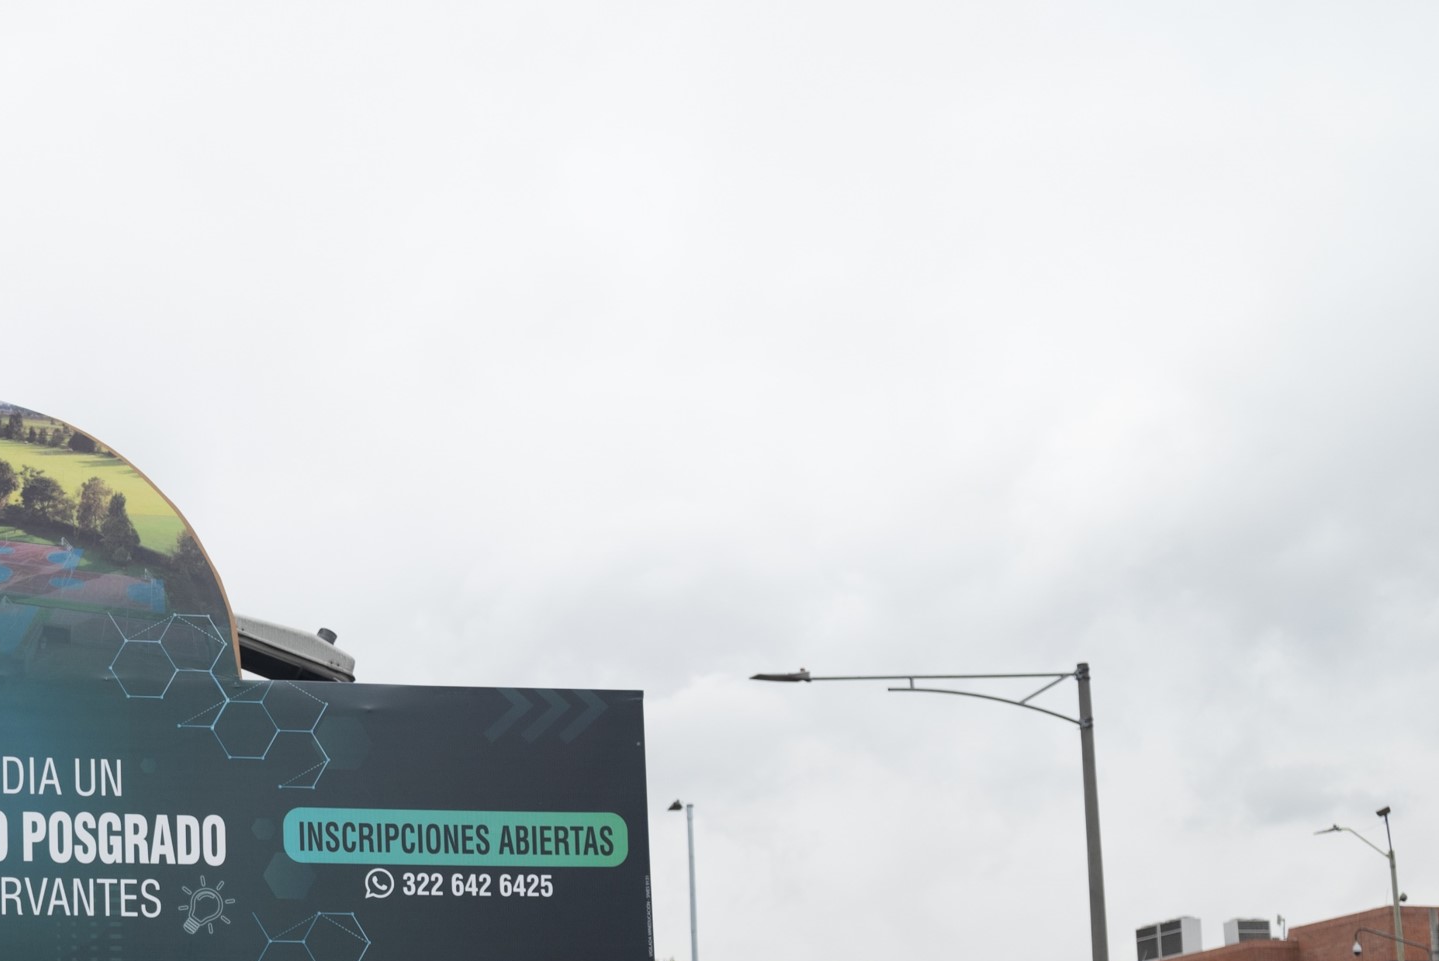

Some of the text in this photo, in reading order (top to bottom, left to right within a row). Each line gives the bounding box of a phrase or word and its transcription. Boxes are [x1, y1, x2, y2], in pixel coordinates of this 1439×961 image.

[75, 758, 121, 796] UN
[23, 811, 226, 866] POSGRADO
[299, 822, 614, 856] INSCRIPCIONES ABIERTAS
[403, 873, 553, 897] 322 642 6425
